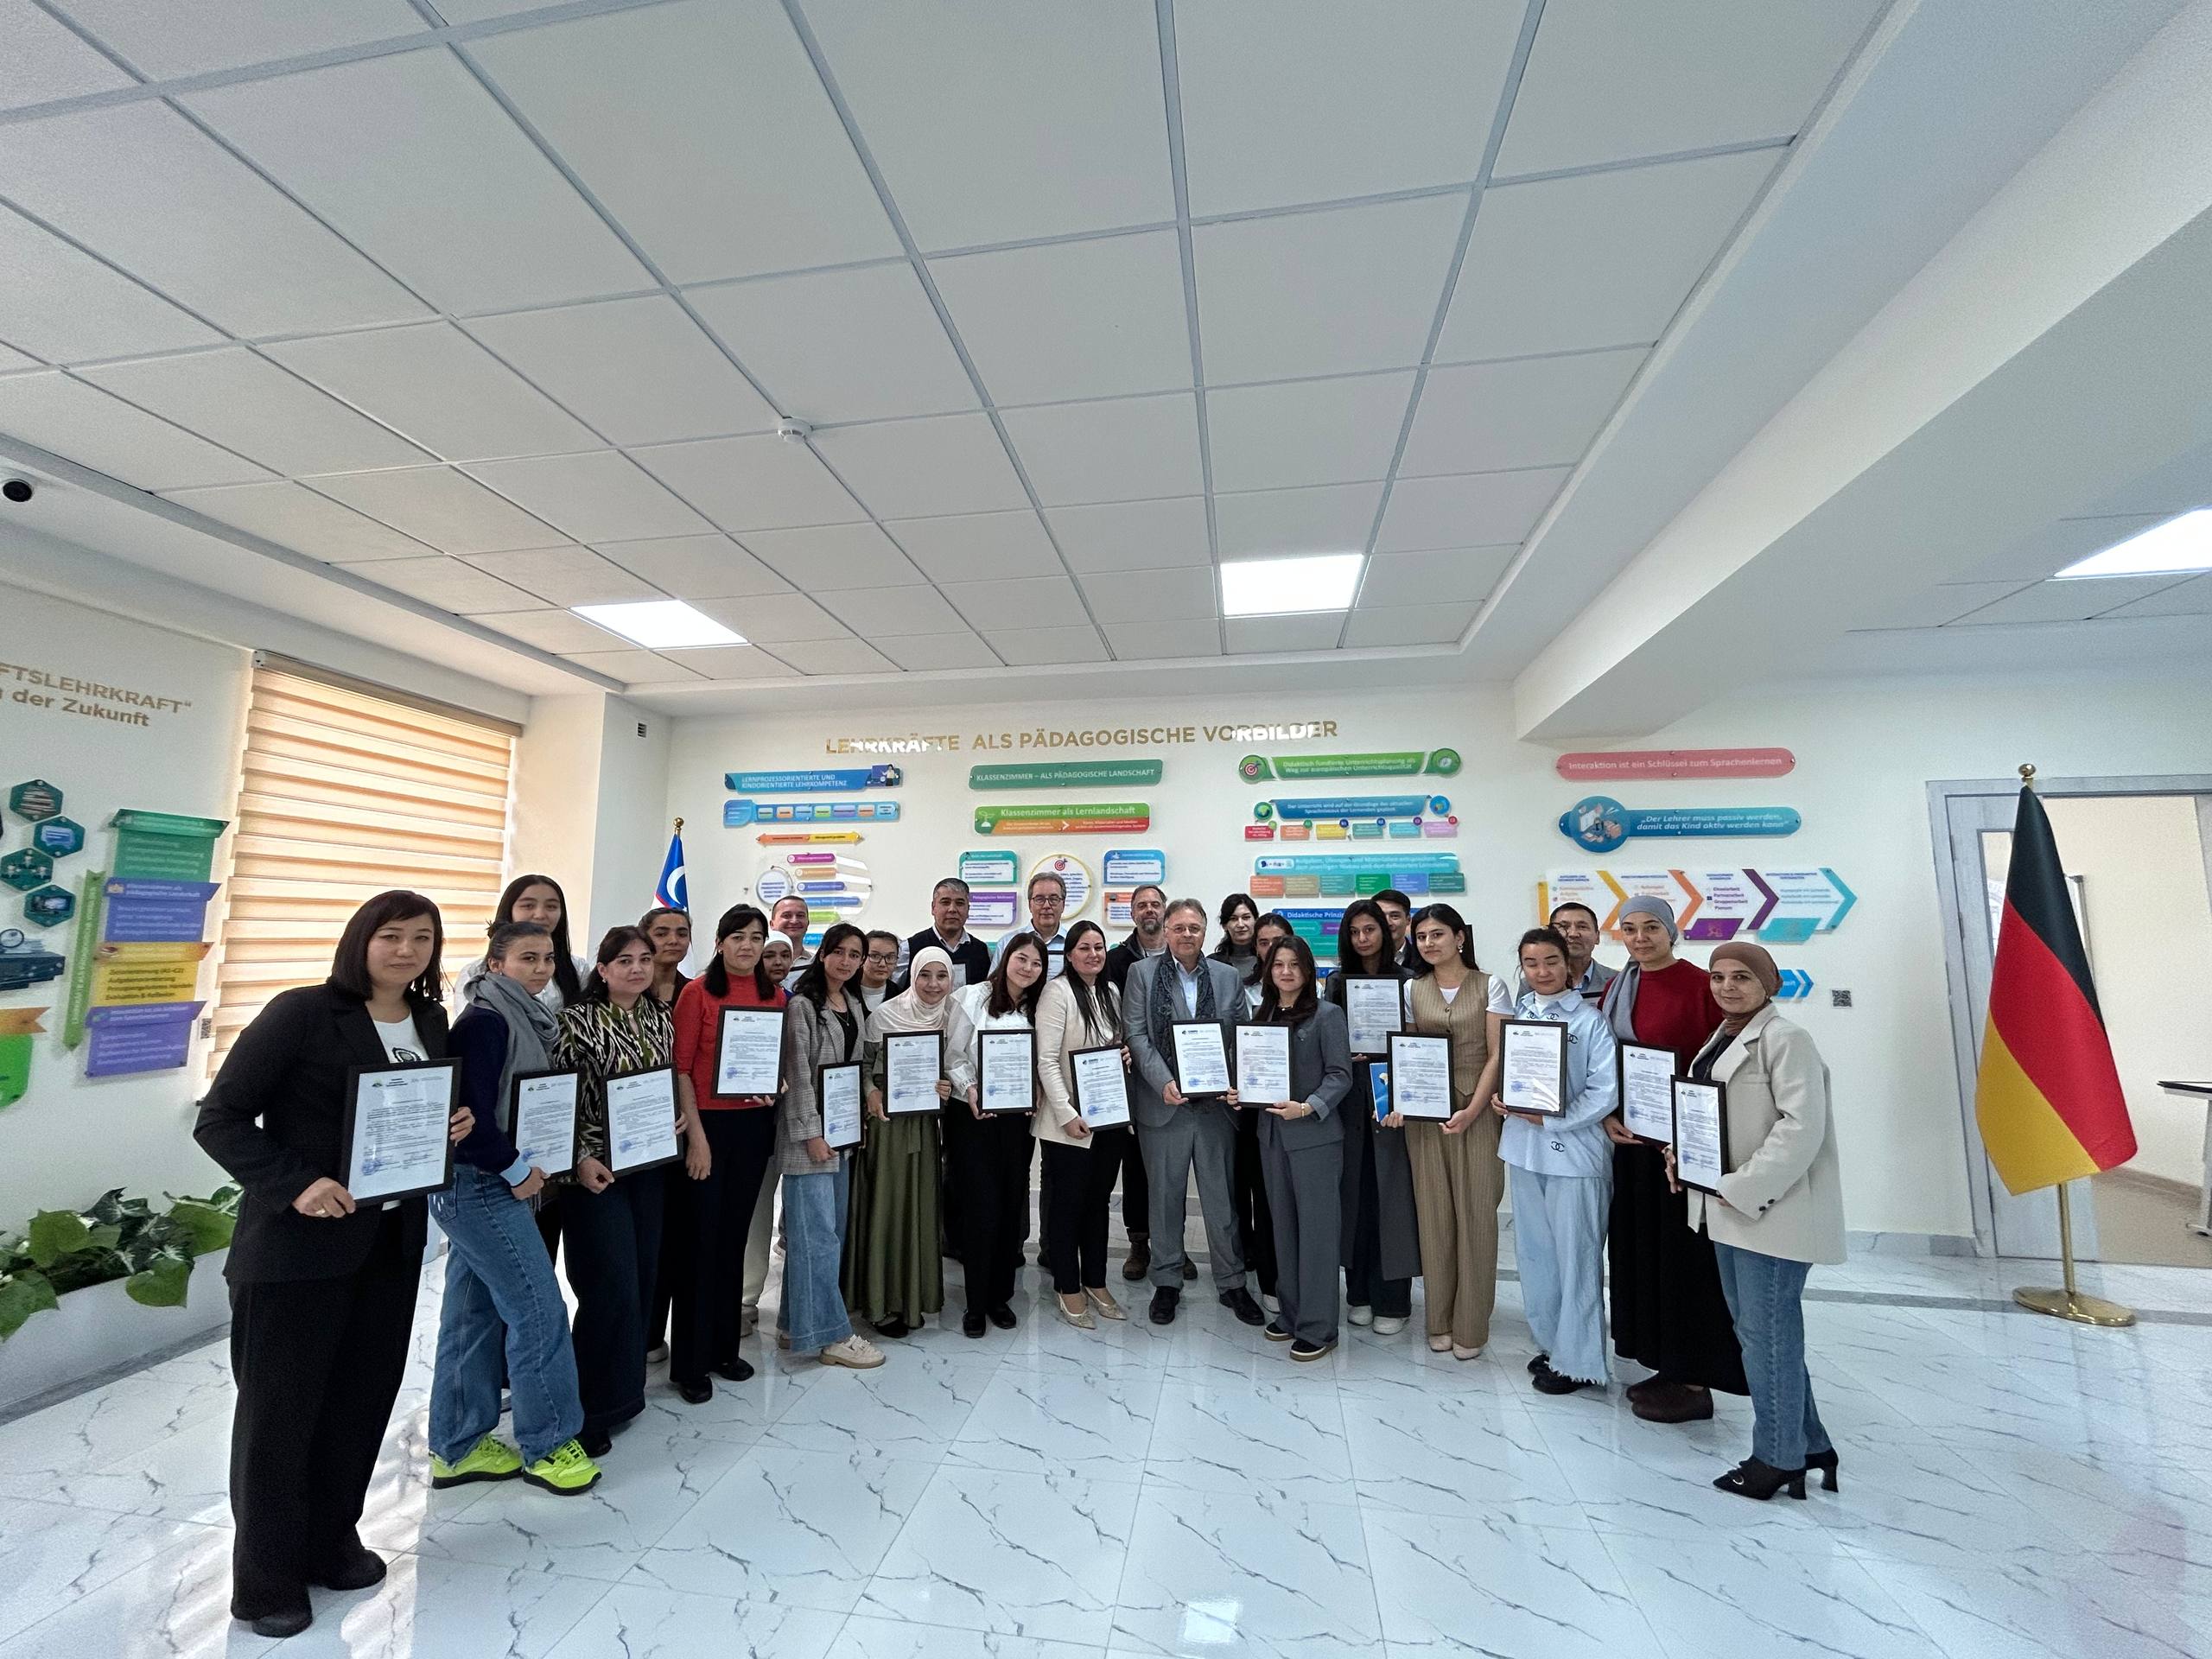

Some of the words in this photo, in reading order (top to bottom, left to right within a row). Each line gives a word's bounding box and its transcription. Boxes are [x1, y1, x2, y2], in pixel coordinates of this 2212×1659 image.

[12, 690, 55, 708] der
[62, 697, 150, 727] Zukunft
[825, 733, 960, 753] LEHRKRÄFTE
[972, 733, 1012, 750] ALS
[1020, 727, 1196, 748] PÄDAGOGISCHE
[1203, 721, 1338, 742] VORBILDER
[1648, 759, 1688, 768] Schlüssel
[1710, 758, 1783, 767] Sprachenlernen
[1053, 770, 1108, 779] PÄDAGOGISCHE
[1001, 808, 1060, 817] Klassenzimmer
[1076, 806, 1135, 816] Lernlandschaft
[1717, 814, 1745, 823] passiv
